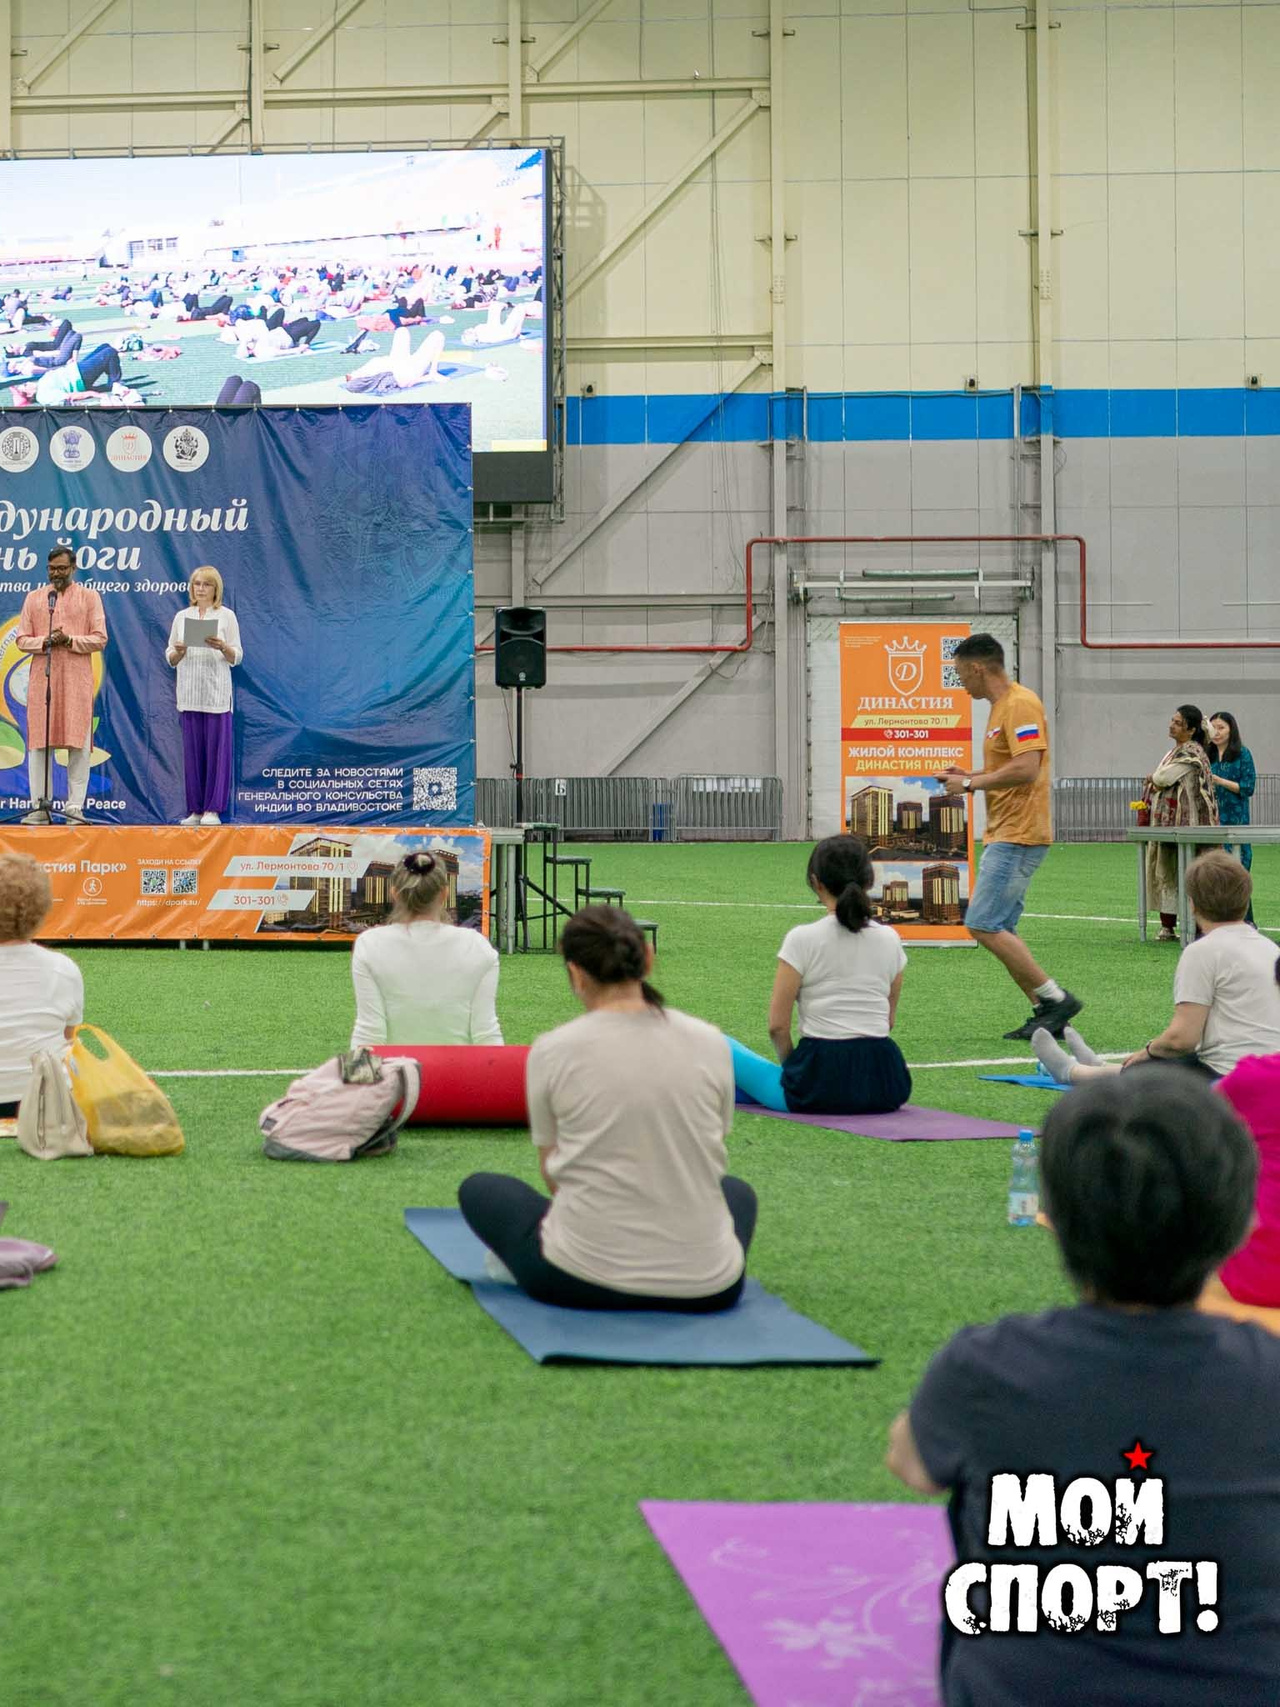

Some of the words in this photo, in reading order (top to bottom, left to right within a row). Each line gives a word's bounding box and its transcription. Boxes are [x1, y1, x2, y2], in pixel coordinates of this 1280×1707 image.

[50, 538, 141, 571] оги
[857, 696, 954, 711] ДИНАСТИЯ
[878, 717, 929, 726] Лермонтова
[931, 717, 948, 725] 70/1
[894, 730, 929, 739] 301-301
[849, 745, 895, 757] ЖИЛОЙ
[898, 747, 964, 758] КОМПЛЕКС
[856, 760, 921, 771] ДИНАСТИЯ
[262, 768, 312, 778] СЛЕДИТЕ
[316, 768, 331, 777] ЗА
[335, 767, 403, 777] НОВОСТЯМИ
[278, 780, 284, 789] В
[289, 780, 363, 790] СОЦИАЛЬНЫХ
[368, 779, 403, 788] СЕТЯХ
[238, 791, 321, 801] ГЕНЕРАЛЬНОГО
[326, 791, 403, 800] КОНСУЛЬСТВА
[86, 798, 126, 809] Peace
[255, 803, 293, 813] ИНДИИ
[297, 803, 312, 812] ВО
[316, 802, 403, 812] ВЛАДИВОСТОКЕ
[81, 859, 127, 875] Парк»
[241, 862, 255, 872] ул.
[257, 861, 319, 873] Лермонтова
[322, 862, 344, 872] 70/1
[234, 895, 275, 905] 301-301
